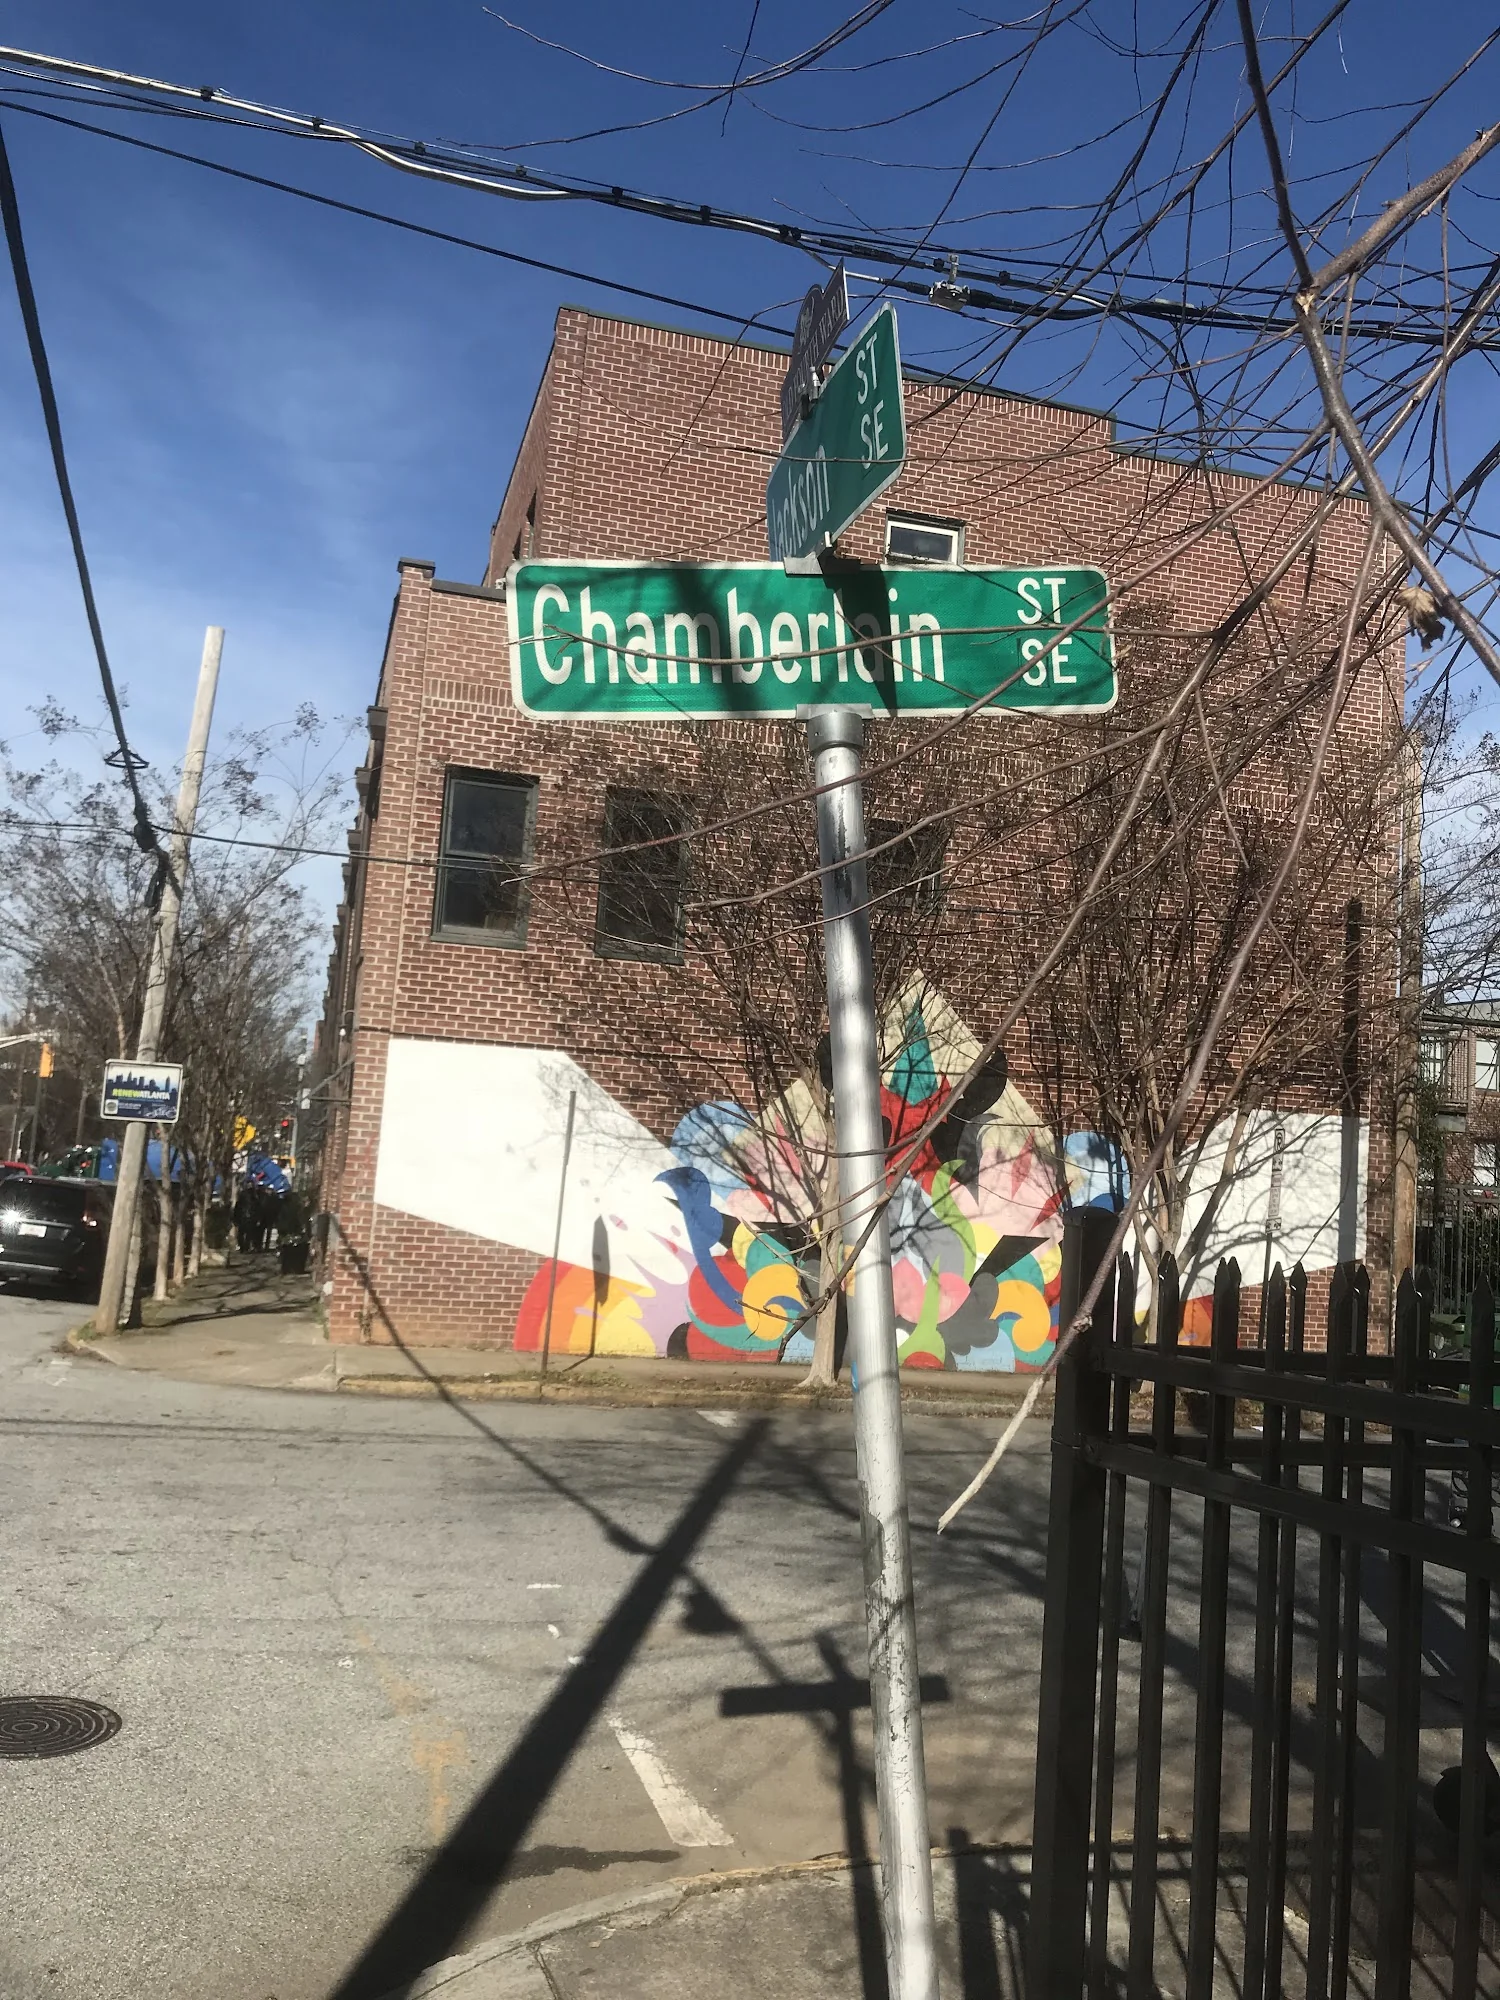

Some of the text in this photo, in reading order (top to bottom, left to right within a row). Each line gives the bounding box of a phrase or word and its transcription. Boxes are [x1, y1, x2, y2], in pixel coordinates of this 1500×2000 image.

[818, 285, 845, 344] WARD
[855, 331, 878, 405] ST
[860, 399, 889, 470] SE
[771, 444, 831, 562] Jackson
[532, 582, 945, 686] Chamberlain
[1018, 577, 1067, 626] ST
[1021, 637, 1078, 687] SE
